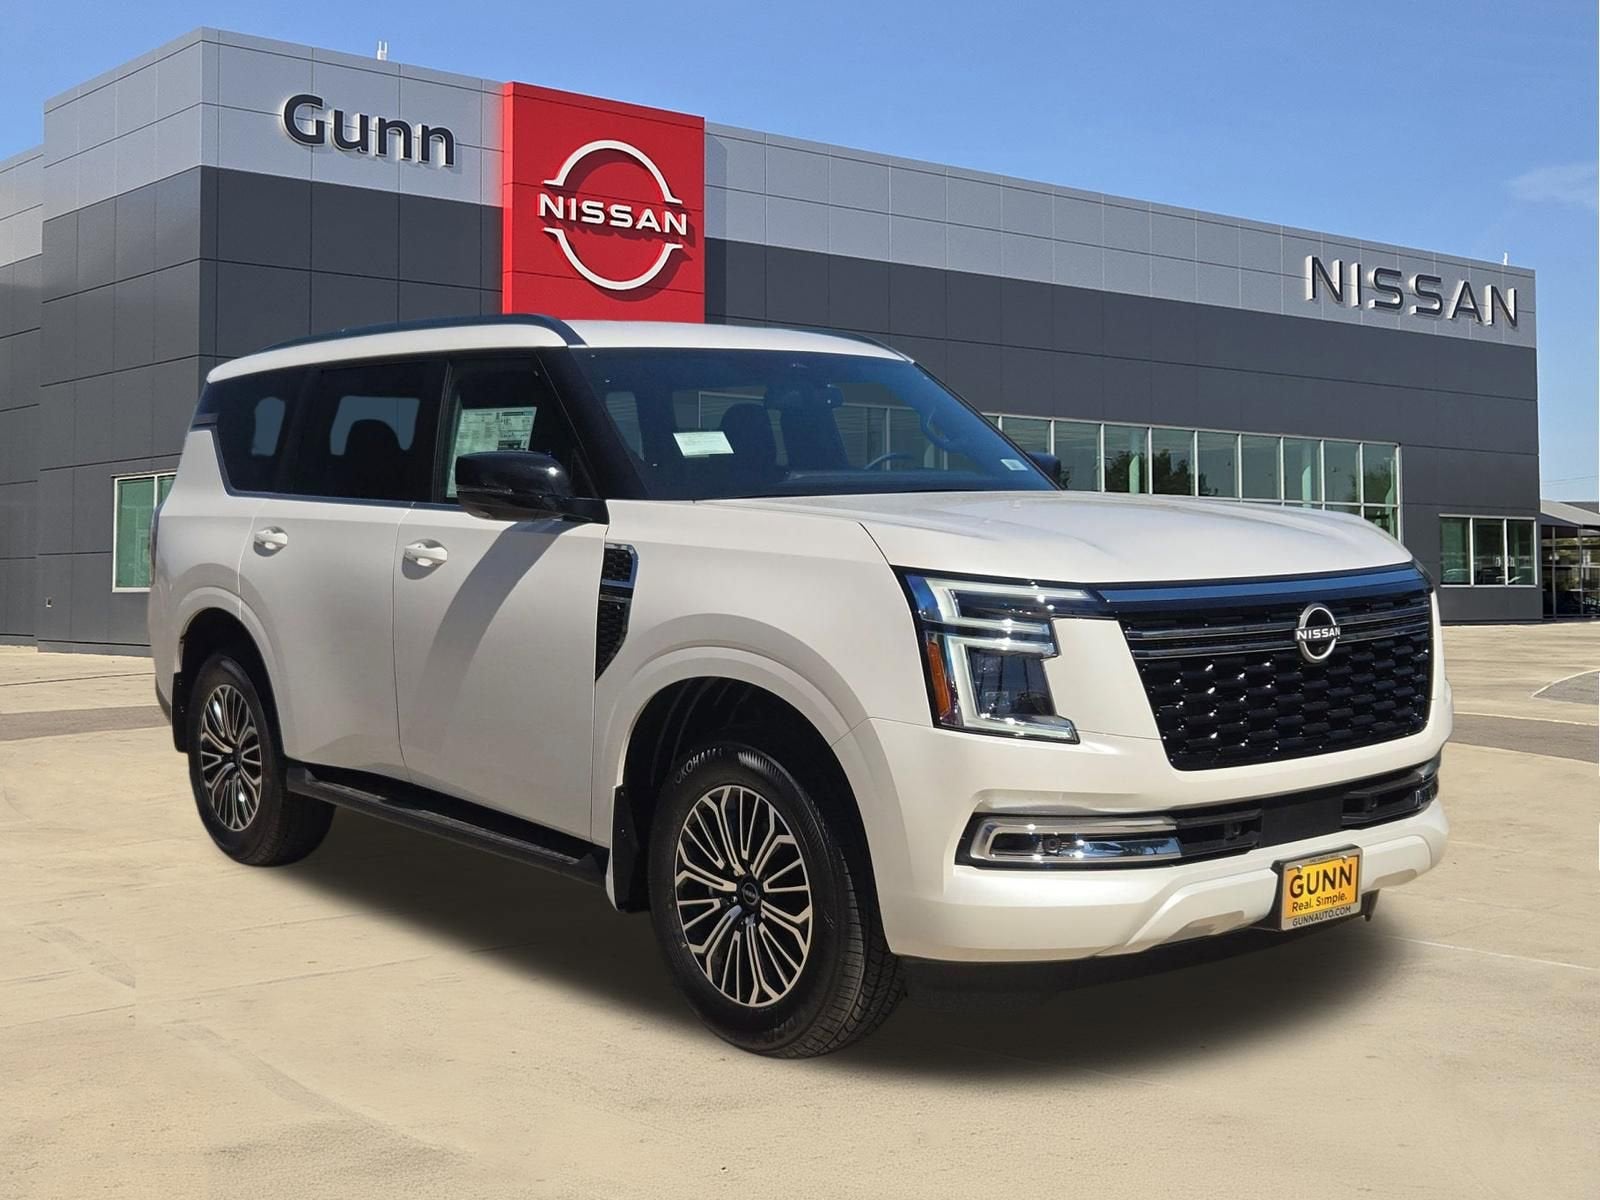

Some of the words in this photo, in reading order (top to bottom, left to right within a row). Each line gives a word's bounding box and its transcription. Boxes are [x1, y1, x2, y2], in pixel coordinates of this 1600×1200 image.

[282, 93, 455, 167] Gunn
[537, 192, 687, 235] NISSAN
[1305, 255, 1518, 327] NISSAN
[1296, 627, 1340, 640] NISSAN
[1289, 863, 1352, 898] GUNN
[1291, 899, 1313, 912] Real.
[1316, 892, 1347, 907] Simple.
[1292, 906, 1351, 927] GUNNAUTO.COM
